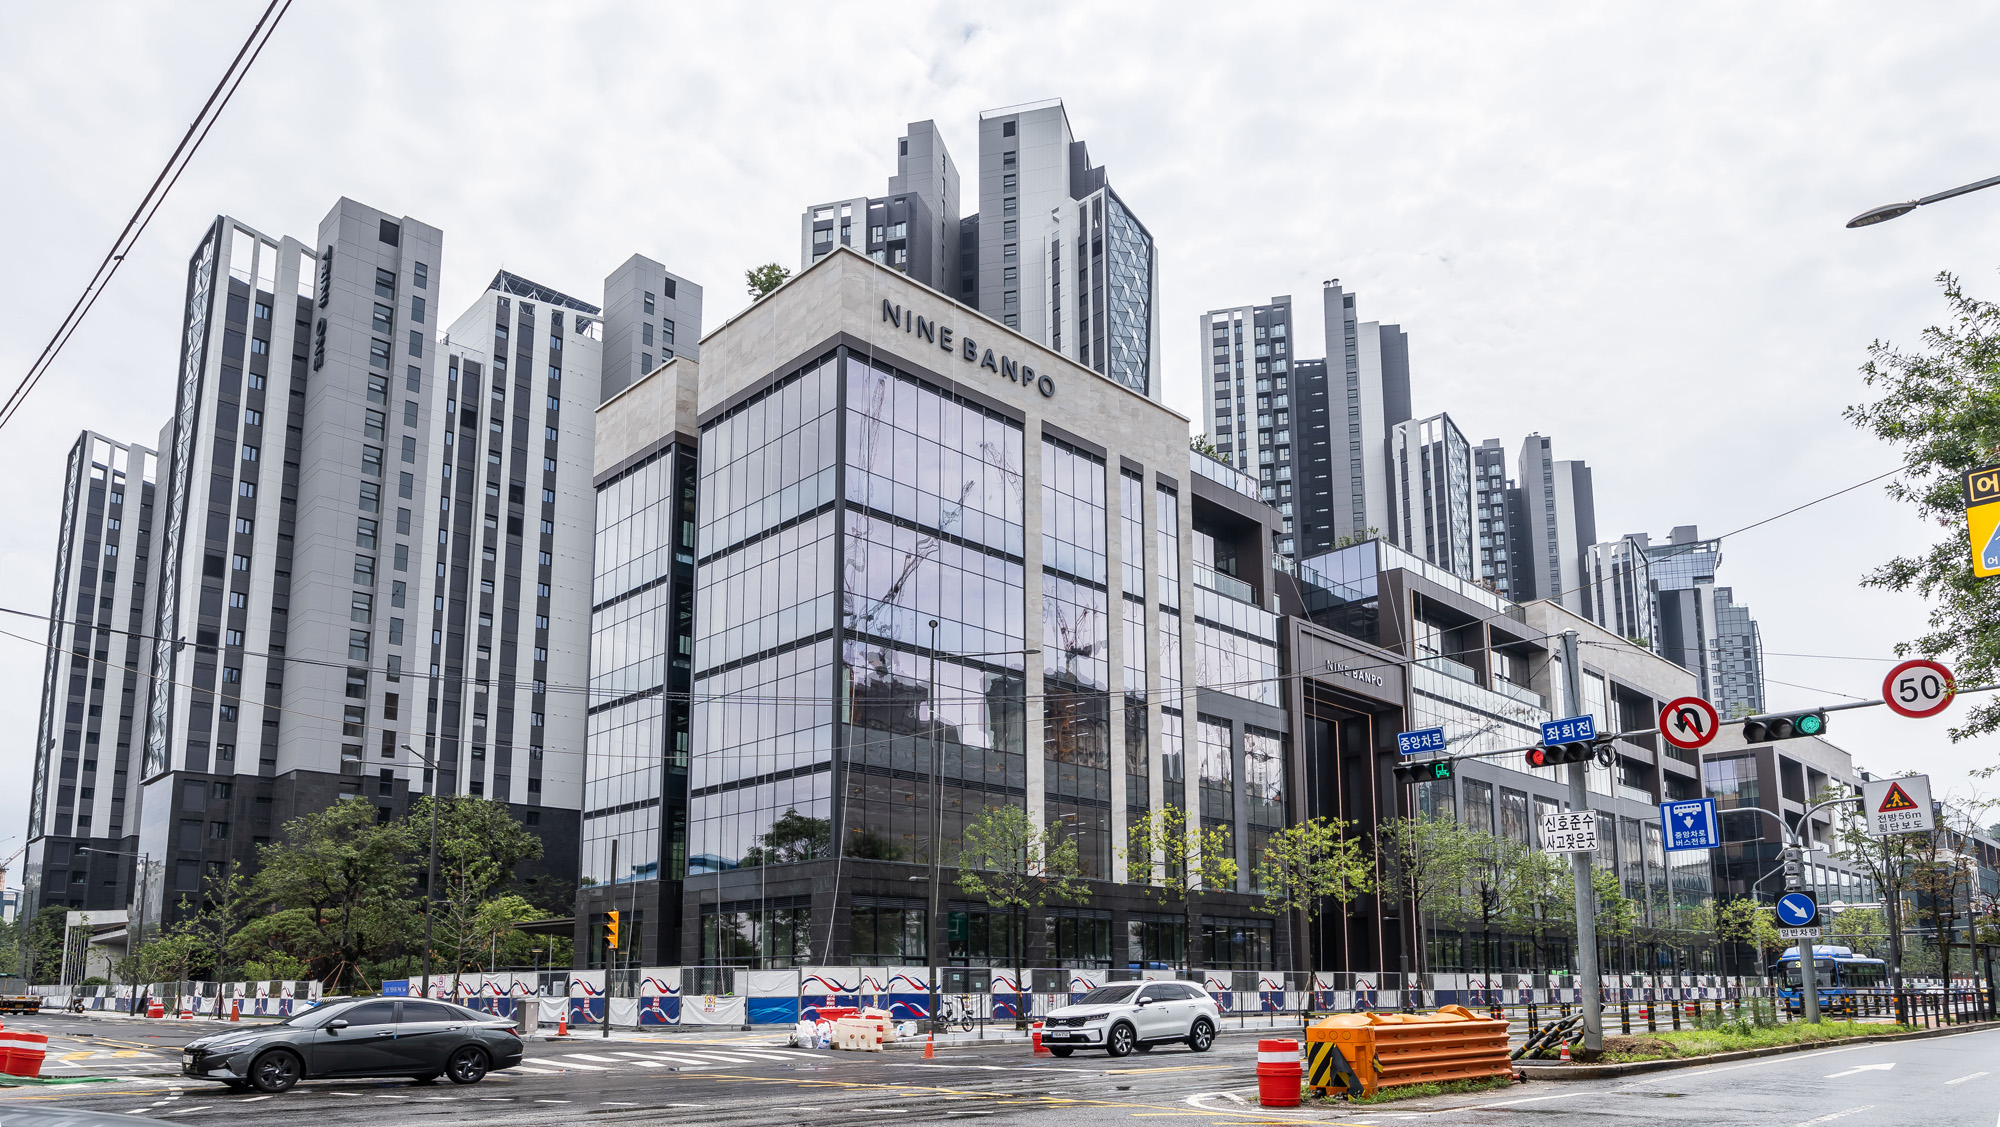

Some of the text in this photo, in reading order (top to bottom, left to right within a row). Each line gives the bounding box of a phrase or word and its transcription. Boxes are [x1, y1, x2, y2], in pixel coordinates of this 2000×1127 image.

[313, 317, 327, 372] ONE
[883, 298, 1056, 397] NINE BANPO
[1326, 660, 1382, 686] NINE BANPO
[1900, 675, 1940, 703] 50
[1546, 720, 1592, 741] 좌회전
[1400, 733, 1443, 751] 중앙차로
[1545, 813, 1594, 832] 신호준수
[1878, 820, 1923, 833] 횡단보도
[1675, 829, 1706, 839] 중앙차로
[1675, 837, 1707, 847] 버스전용
[1780, 928, 1818, 937] 일반차량
